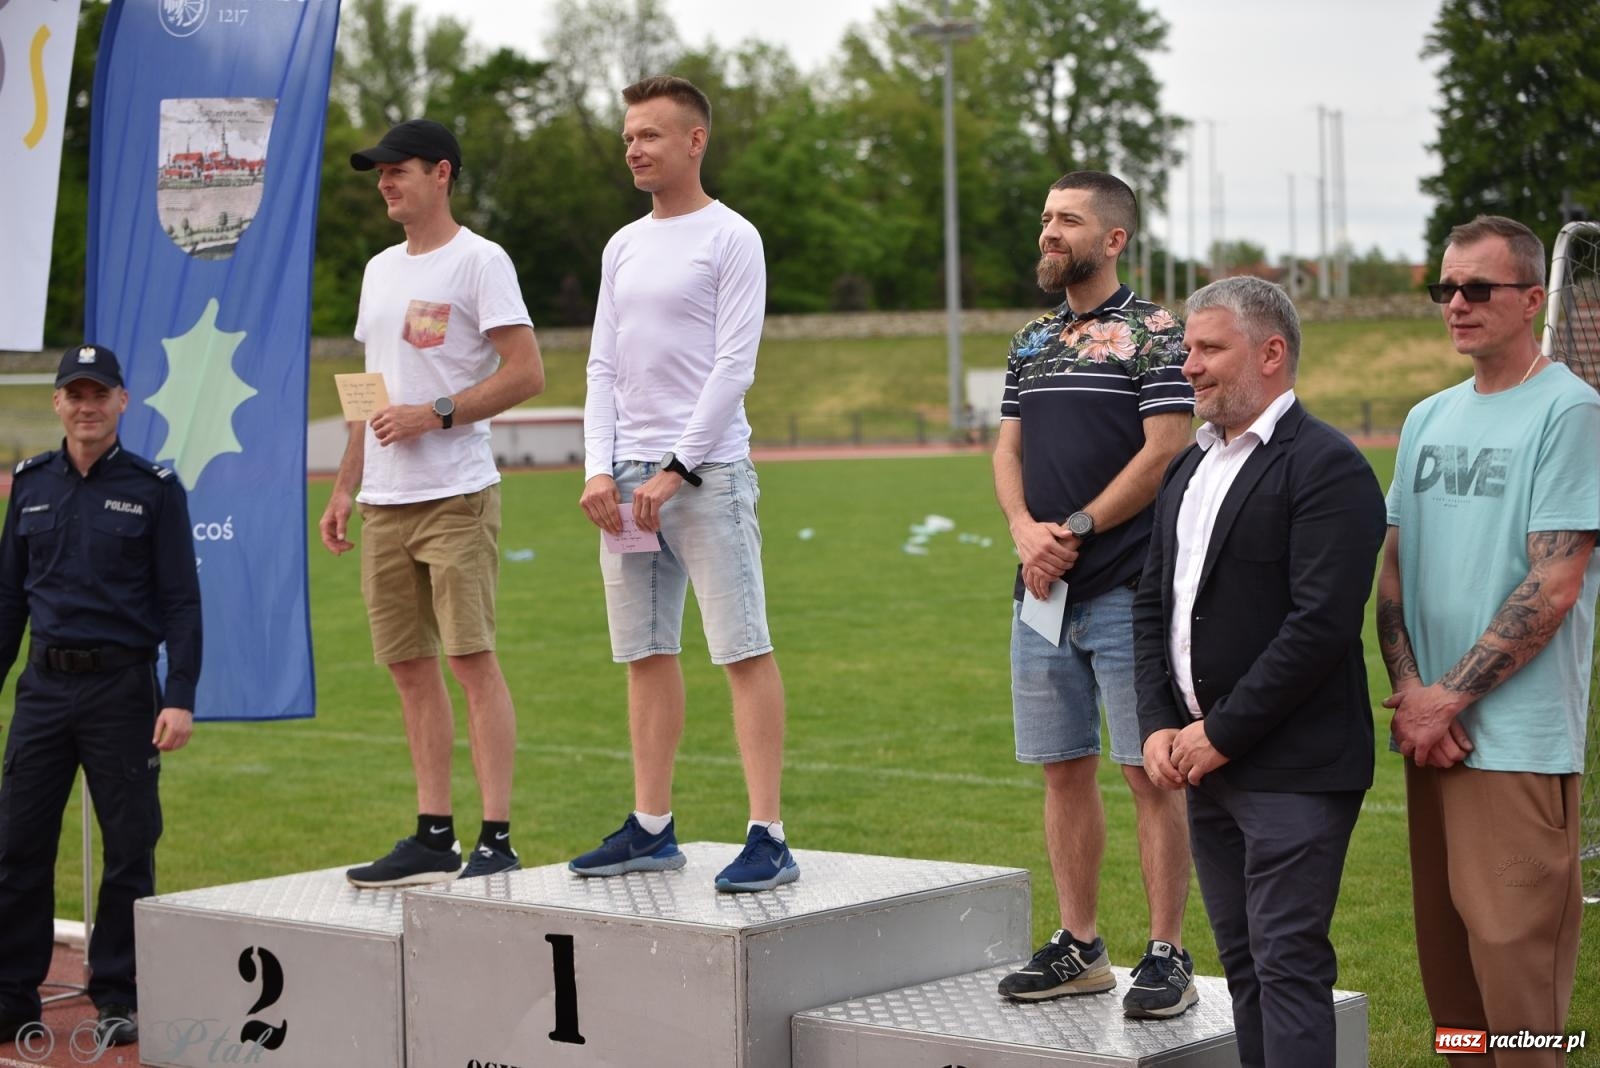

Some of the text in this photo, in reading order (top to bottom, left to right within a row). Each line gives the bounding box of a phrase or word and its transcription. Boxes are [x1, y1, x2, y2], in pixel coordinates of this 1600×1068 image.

[217, 9, 249, 27] 1217
[104, 499, 143, 515] POLICJA
[192, 515, 234, 541] coś
[238, 946, 288, 1051] 2
[544, 933, 586, 1045] 1
